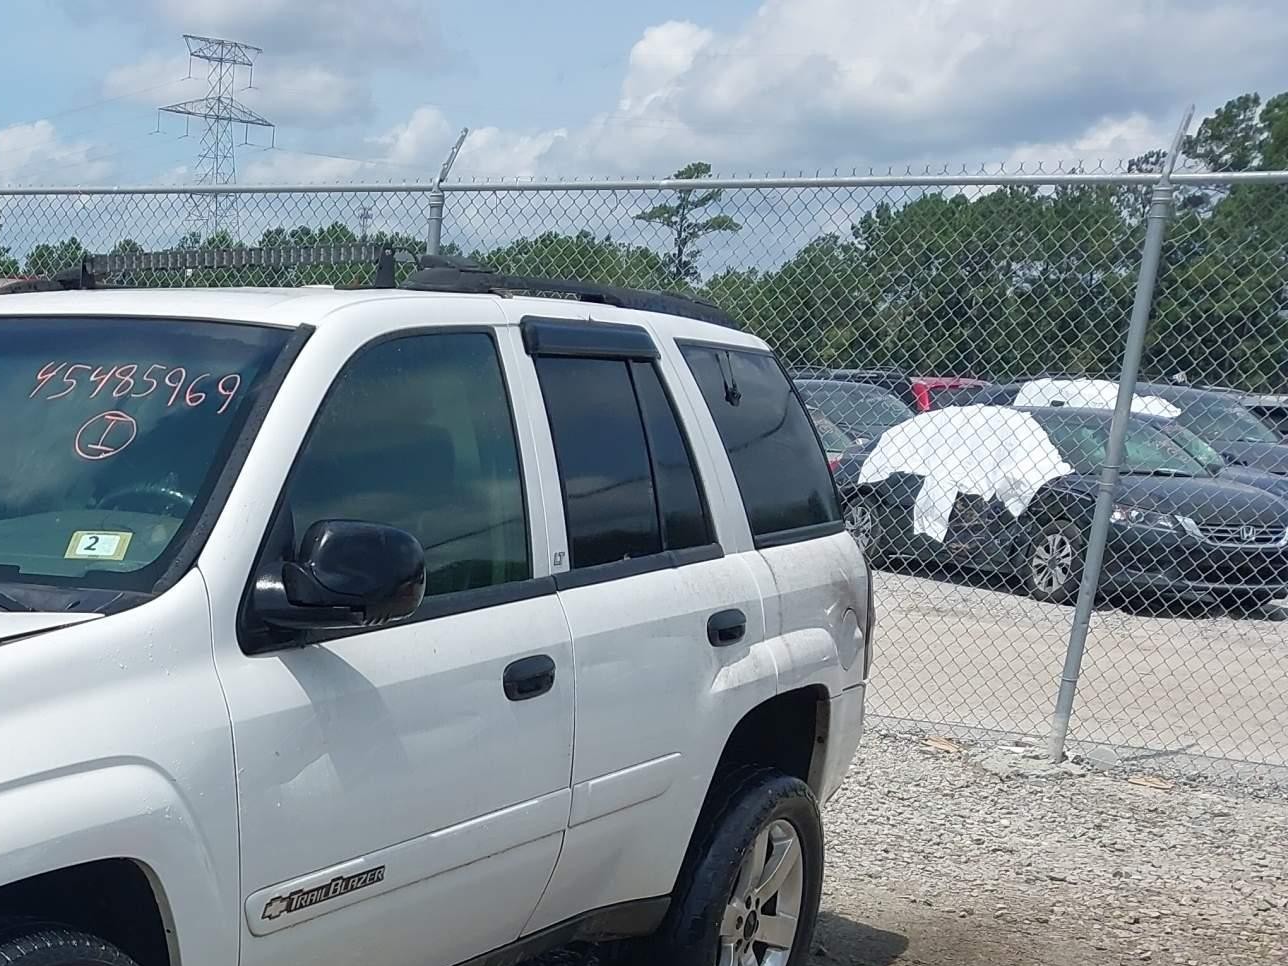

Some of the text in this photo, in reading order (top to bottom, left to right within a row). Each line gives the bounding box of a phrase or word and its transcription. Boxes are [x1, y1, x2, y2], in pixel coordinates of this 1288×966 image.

[29, 360, 242, 415] 45485969
[83, 535, 100, 551] 2
[553, 551, 566, 566] LT
